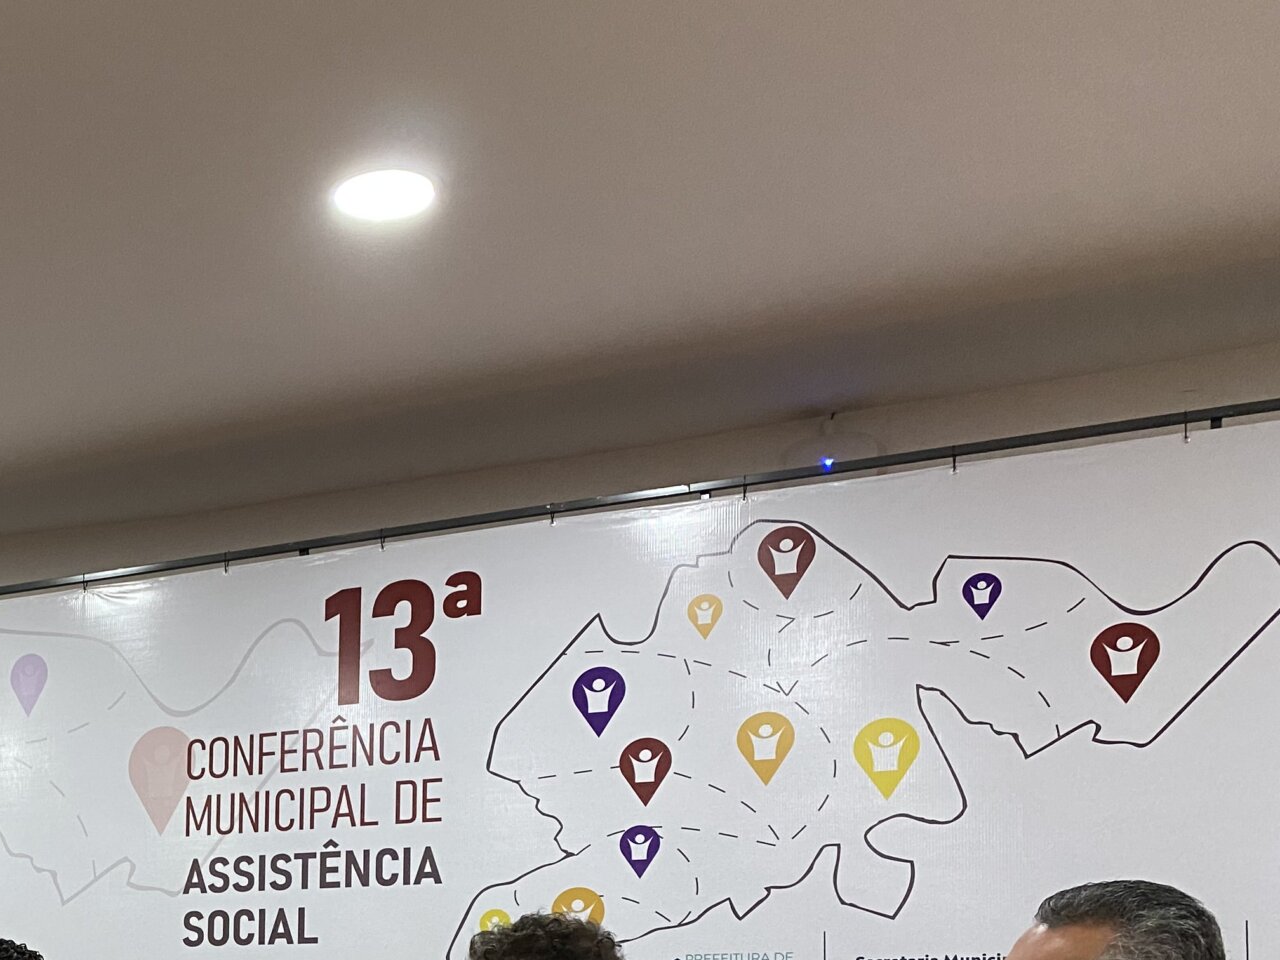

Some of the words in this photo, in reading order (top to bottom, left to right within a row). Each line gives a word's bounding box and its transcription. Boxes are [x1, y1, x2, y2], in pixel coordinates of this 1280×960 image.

[324, 570, 483, 706] 13ª
[186, 714, 441, 780] CONFERÊNCIA
[185, 783, 379, 837] MUNICIPAL
[395, 777, 443, 825] DE
[182, 838, 443, 895] ASSISTÊNCIA
[182, 907, 319, 948] SOCIAL
